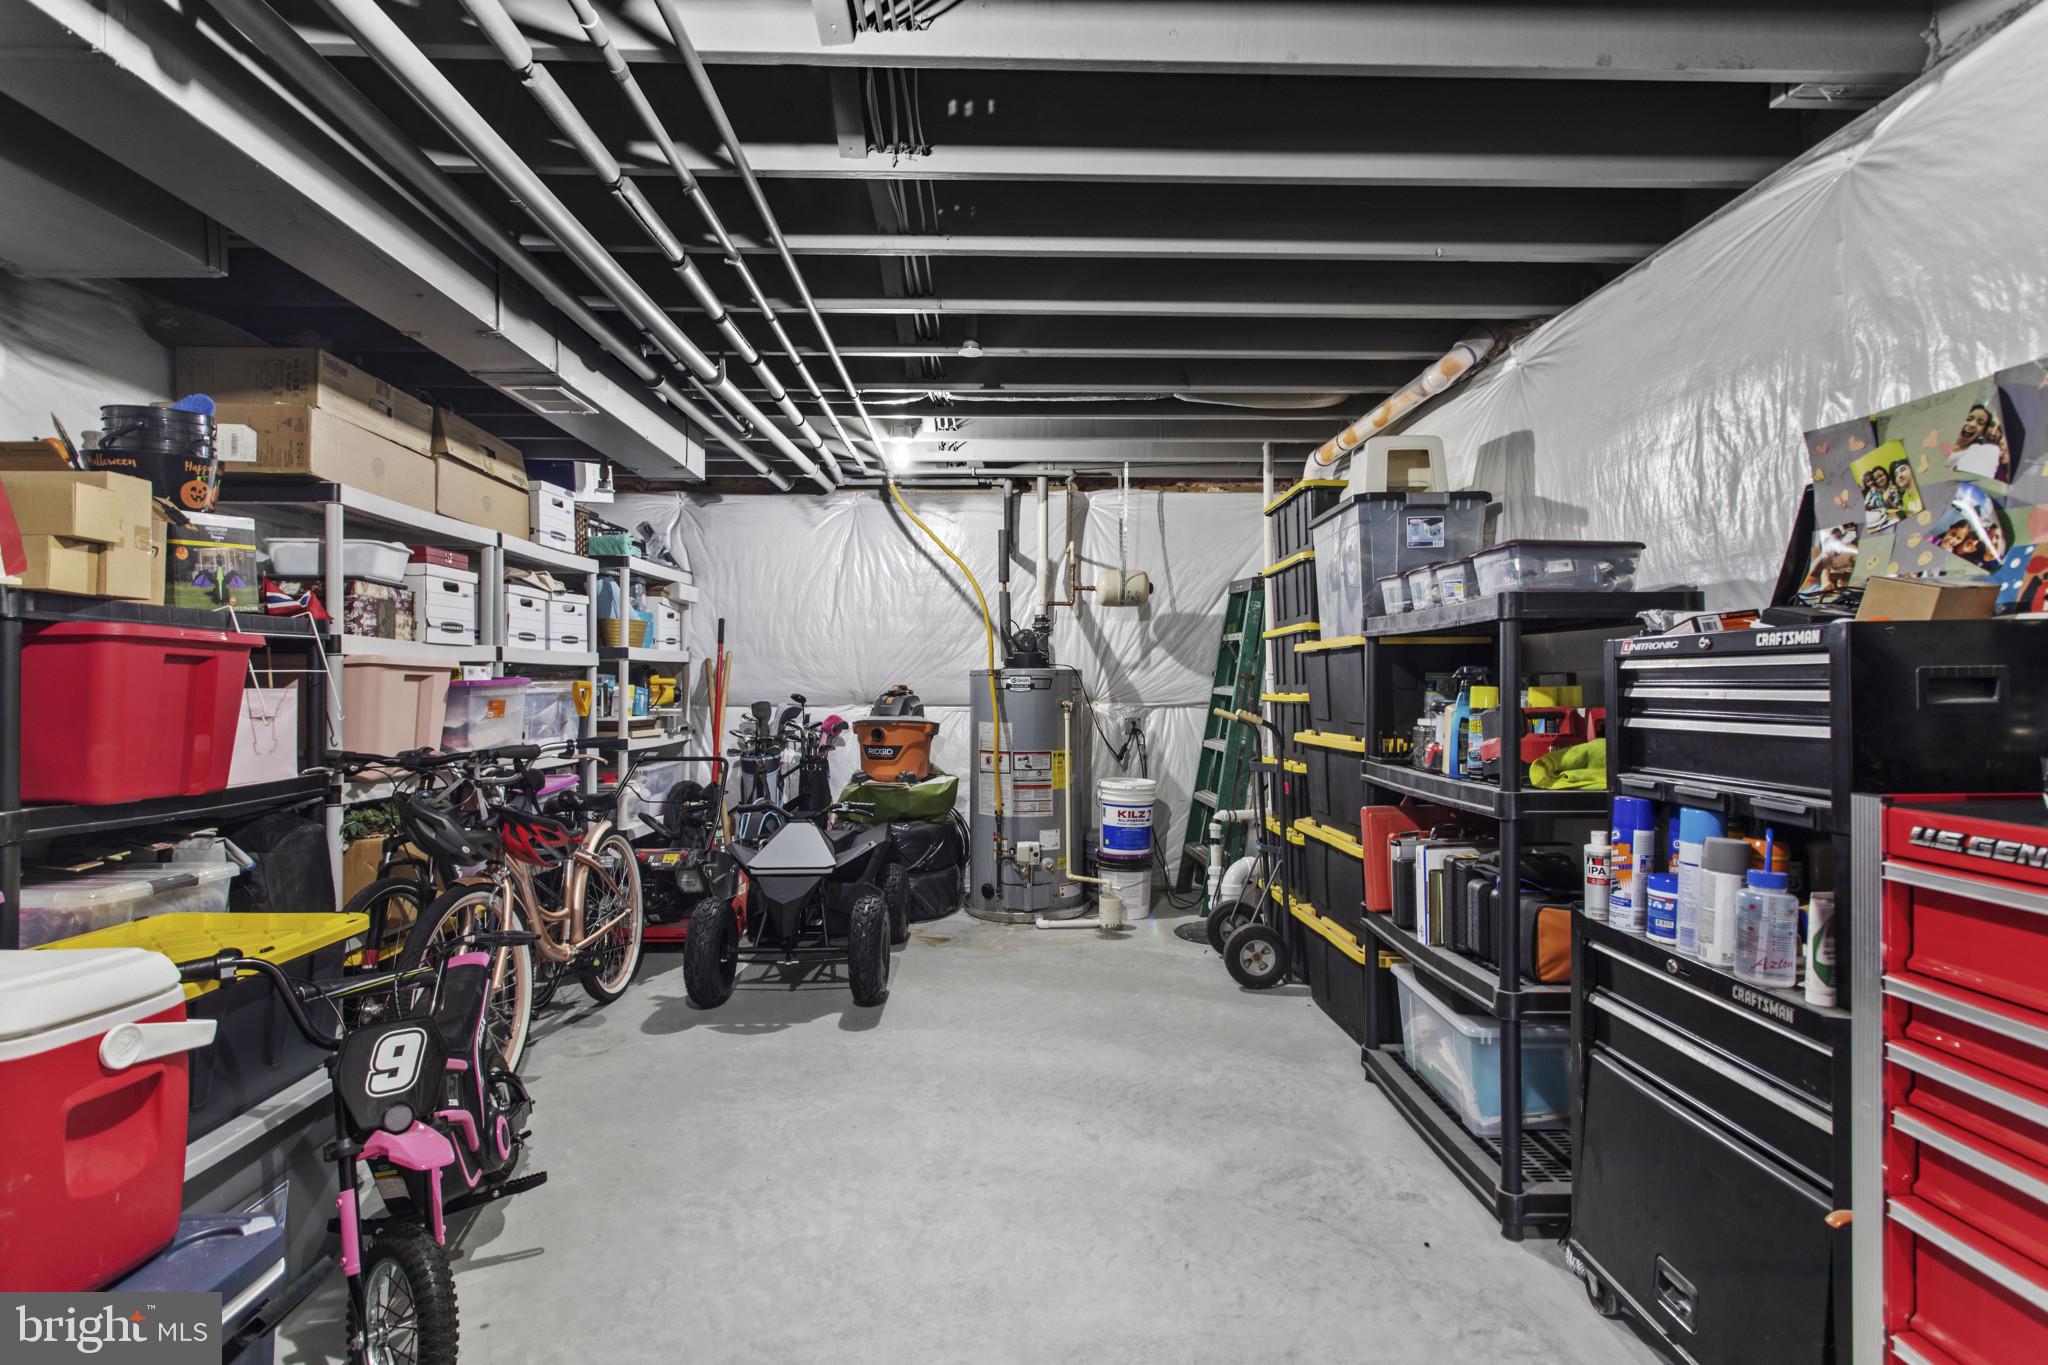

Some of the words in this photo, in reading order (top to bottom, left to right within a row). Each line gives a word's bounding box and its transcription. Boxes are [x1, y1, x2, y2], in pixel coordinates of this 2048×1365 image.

[1755, 629, 1821, 646] CRAFTSMAN
[1621, 640, 1679, 654] UNITRONIC
[1117, 810, 1146, 818] KILZ
[1966, 836, 2048, 870] GEN
[1588, 865, 1606, 876] IPA
[1749, 957, 1793, 971] Azlon
[1732, 984, 1795, 1025] CRAFTSMAN
[365, 1027, 427, 1097] 9
